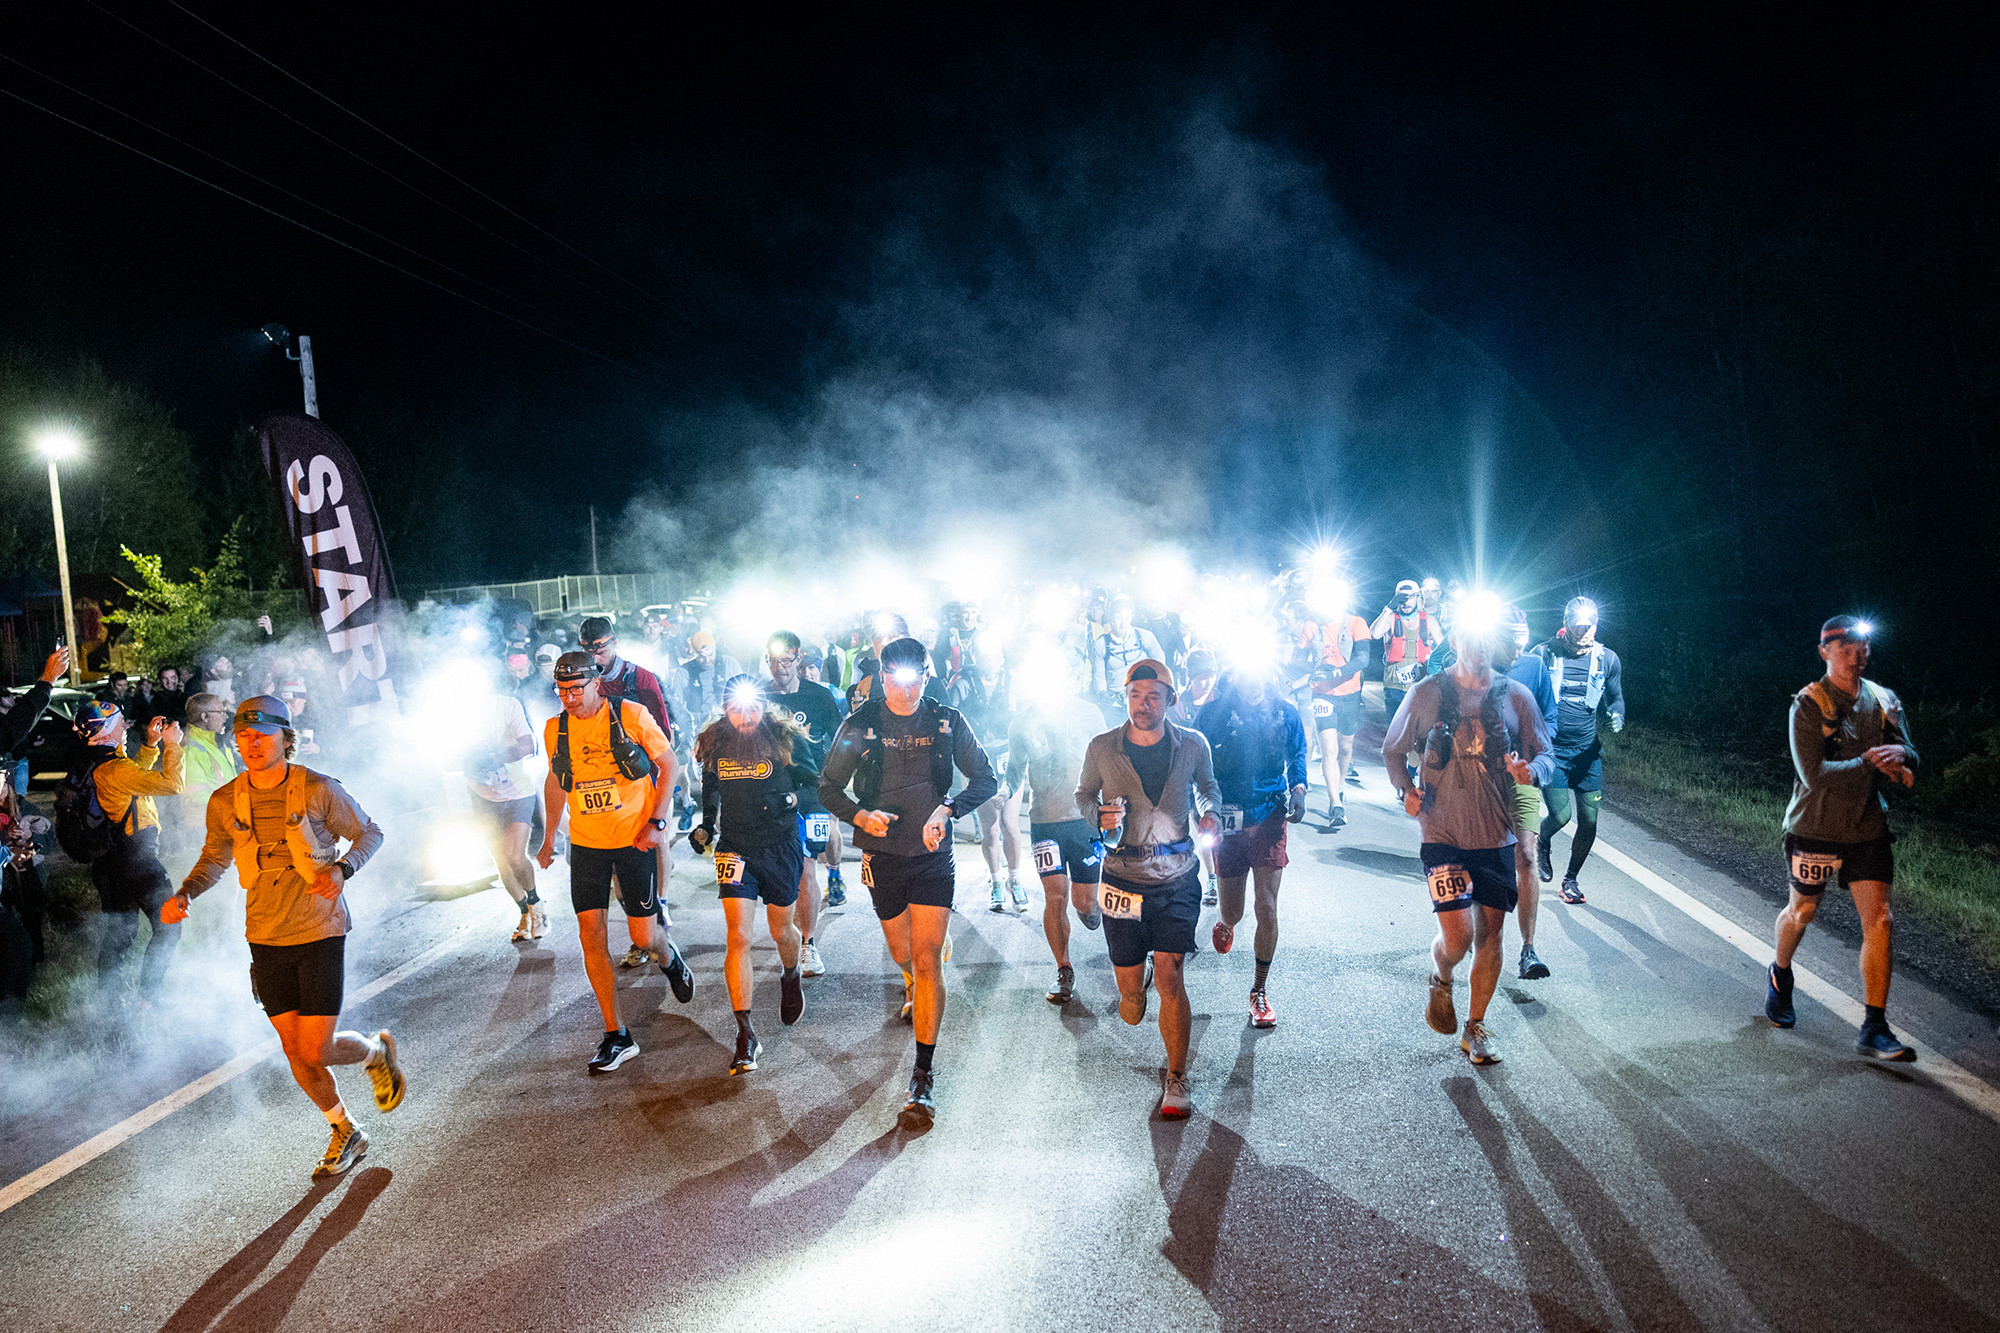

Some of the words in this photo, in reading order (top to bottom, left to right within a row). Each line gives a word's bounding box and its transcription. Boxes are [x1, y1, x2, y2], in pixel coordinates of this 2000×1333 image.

[287, 455, 402, 730] START
[720, 768, 759, 778] Running
[581, 779, 611, 789] SUPERIOR
[584, 791, 613, 809] 602
[1800, 863, 1834, 880] 690
[1436, 876, 1467, 897] 699
[1104, 892, 1131, 913] 679
